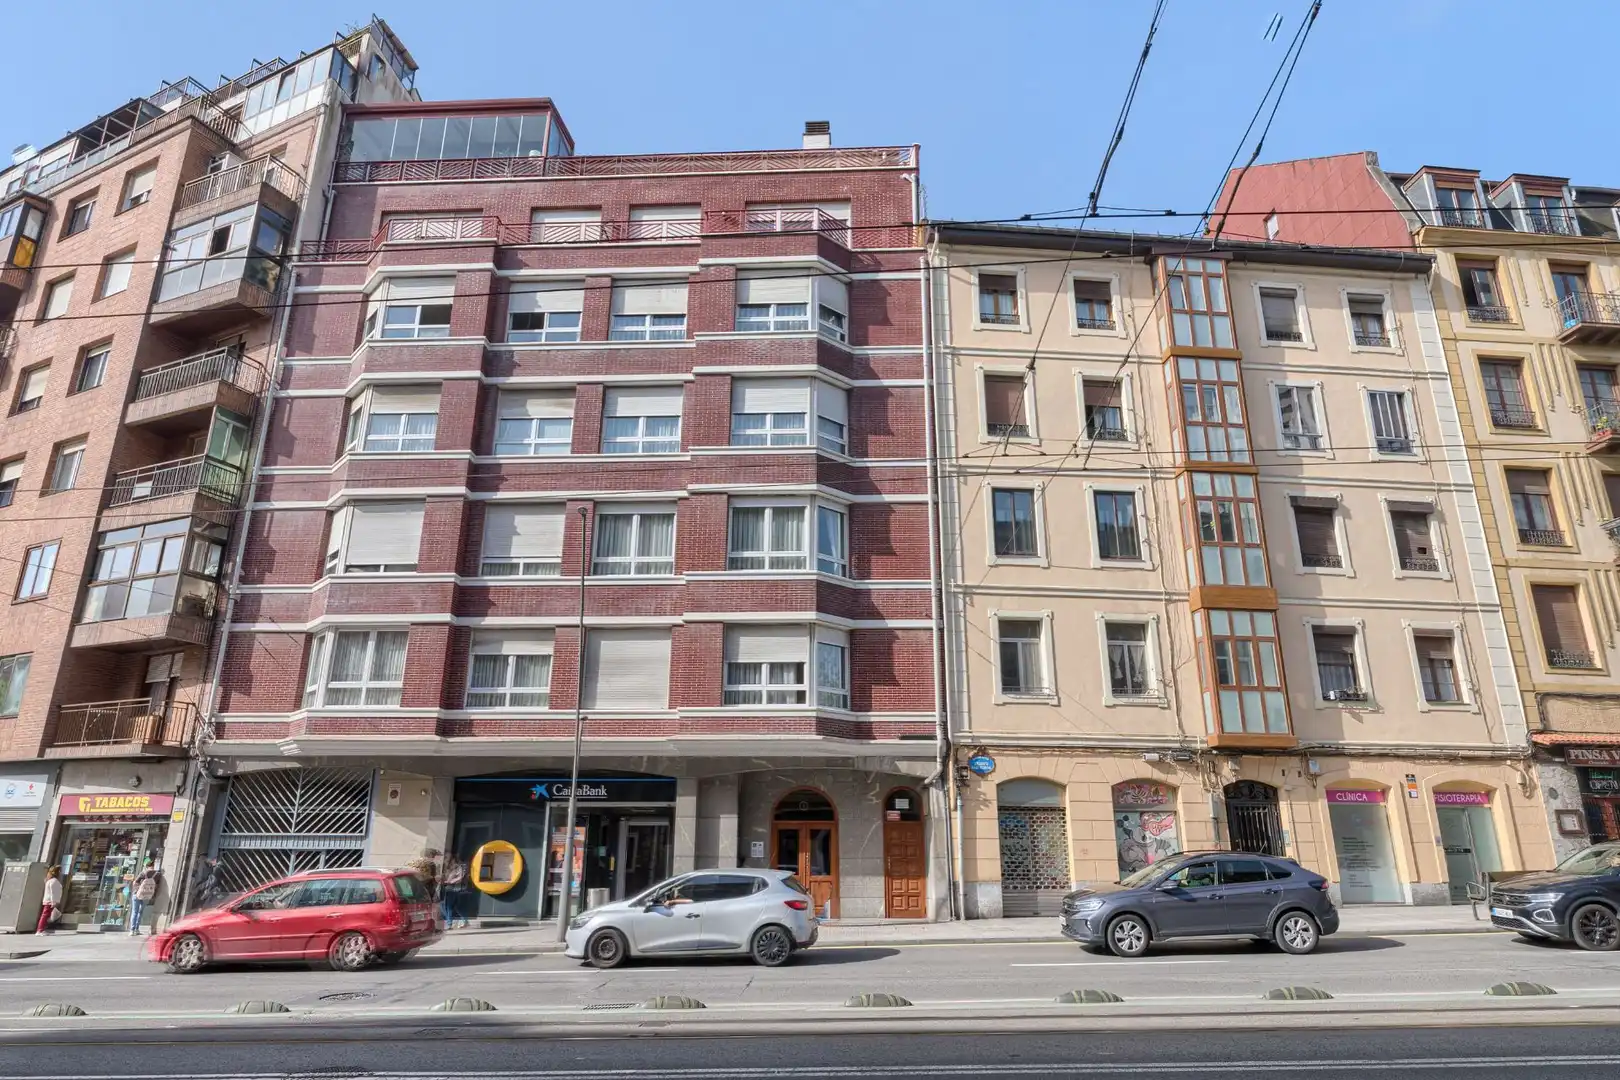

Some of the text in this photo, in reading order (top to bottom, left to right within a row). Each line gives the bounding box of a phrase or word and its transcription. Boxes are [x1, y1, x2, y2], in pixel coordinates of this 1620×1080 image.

[1569, 749, 1610, 760] PINSA
[553, 783, 608, 796] CaiaBank
[94, 796, 150, 808] TABACOS
[1335, 791, 1368, 802] CLÍNICA
[1433, 792, 1482, 803] FISIOTERAPIA
